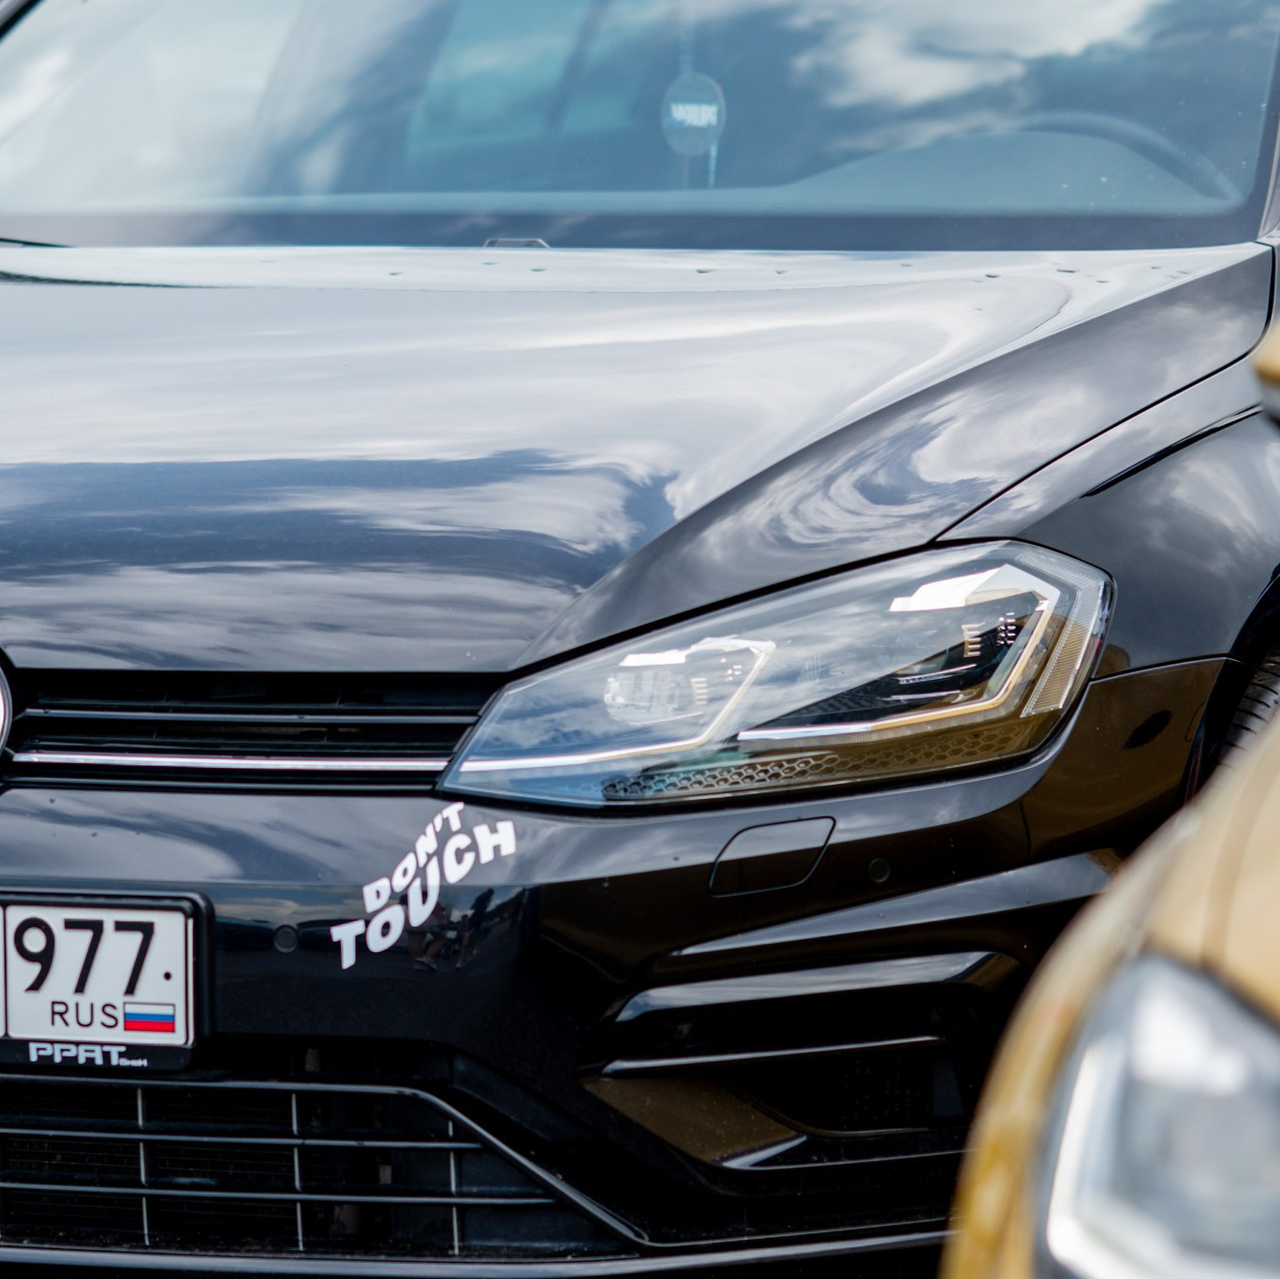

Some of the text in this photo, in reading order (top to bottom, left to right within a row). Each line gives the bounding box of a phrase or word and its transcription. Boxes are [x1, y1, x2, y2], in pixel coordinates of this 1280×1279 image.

[329, 820, 517, 970] TOUCH
[362, 801, 465, 913] DON'T
[13, 917, 155, 996] 977
[28, 1041, 127, 1066] PPAT
[50, 1000, 119, 1029] RUS
